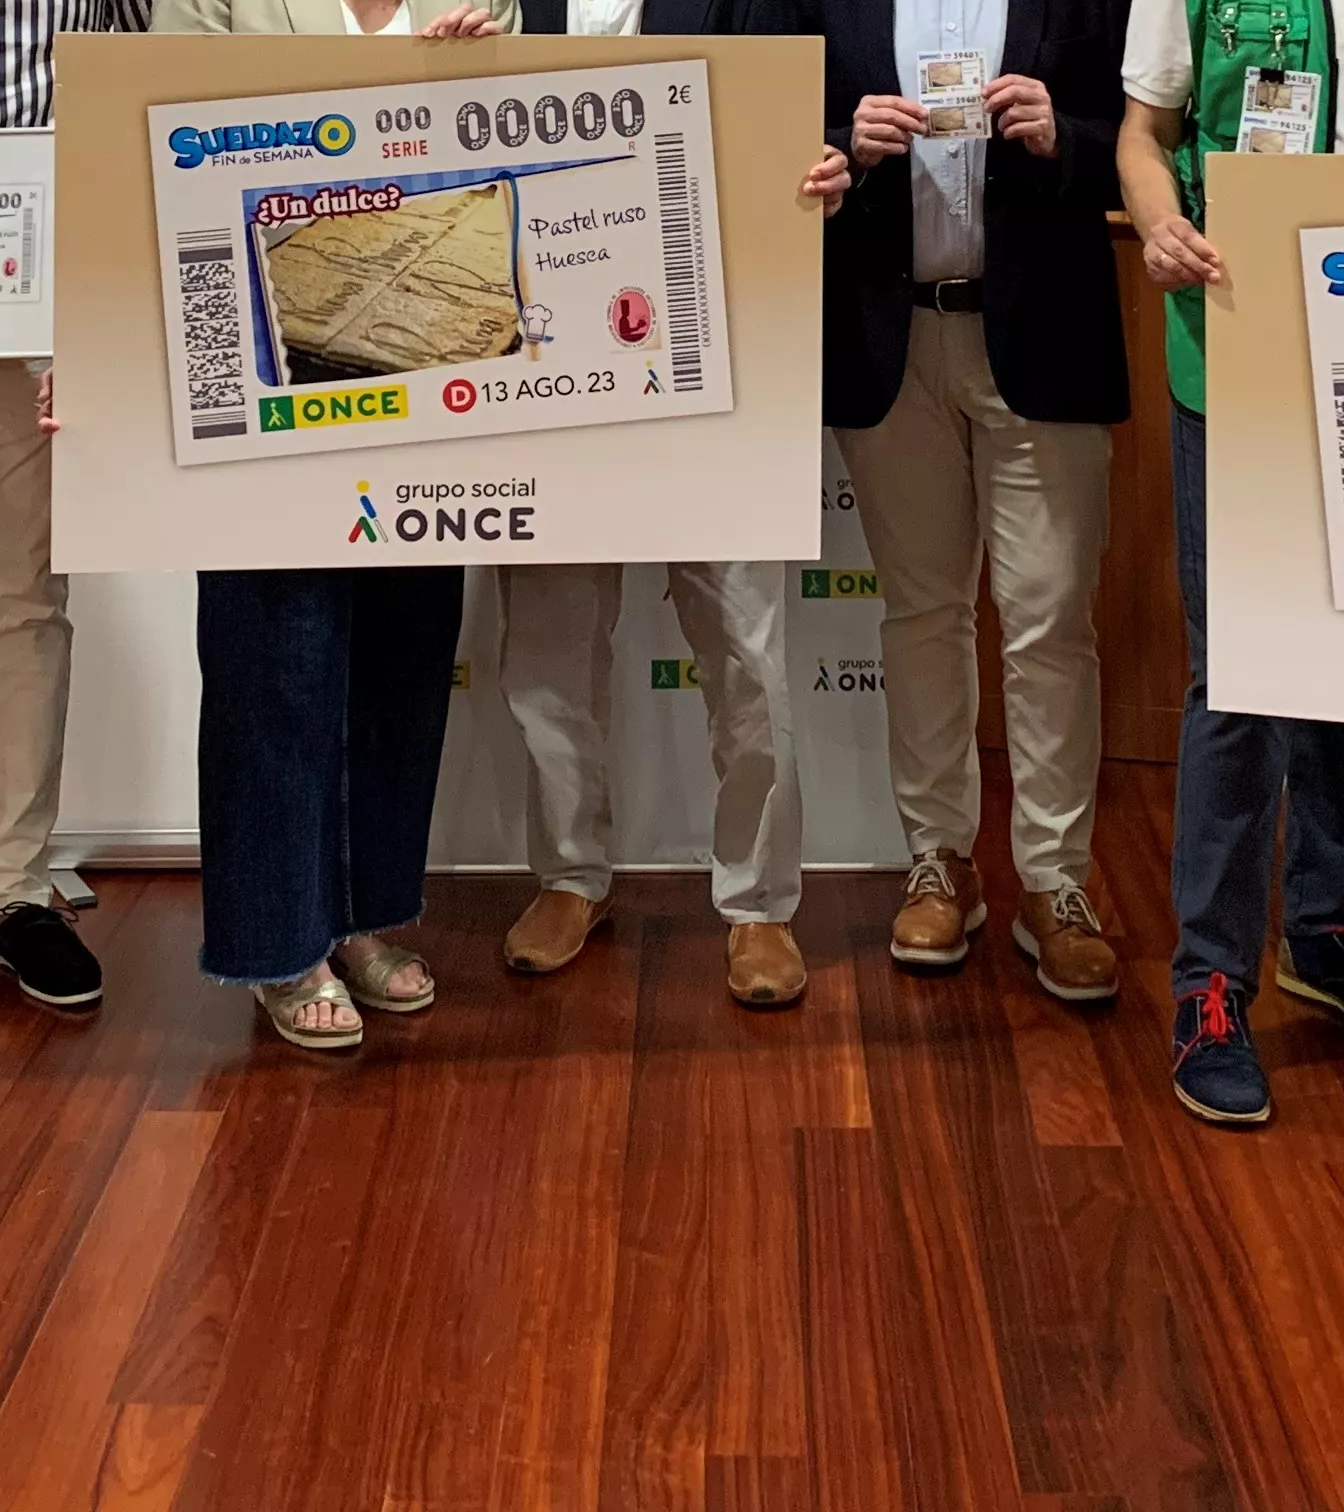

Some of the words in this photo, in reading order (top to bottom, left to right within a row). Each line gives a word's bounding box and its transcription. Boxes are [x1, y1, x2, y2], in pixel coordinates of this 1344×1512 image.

[668, 85, 692, 105] 2€
[375, 106, 431, 133] 000
[457, 89, 645, 151] 00000
[169, 114, 356, 169] SUELDAZO
[382, 140, 428, 158] SERIE
[628, 142, 636, 151] R
[239, 155, 251, 164] de
[254, 148, 313, 163] SEMANA
[258, 197, 308, 221] ¿Un
[313, 186, 401, 214] dulce?
[528, 209, 599, 239] Pastel
[603, 206, 646, 226] ruso
[536, 248, 611, 271] Huesca
[451, 385, 470, 407] D
[481, 382, 509, 404] 13
[516, 374, 582, 400] AGO.
[587, 370, 616, 393] 23
[302, 390, 400, 422] ONCE
[396, 480, 465, 503] grupo
[472, 478, 536, 497] social
[395, 507, 535, 542] ONCE
[838, 659, 874, 671] grupo
